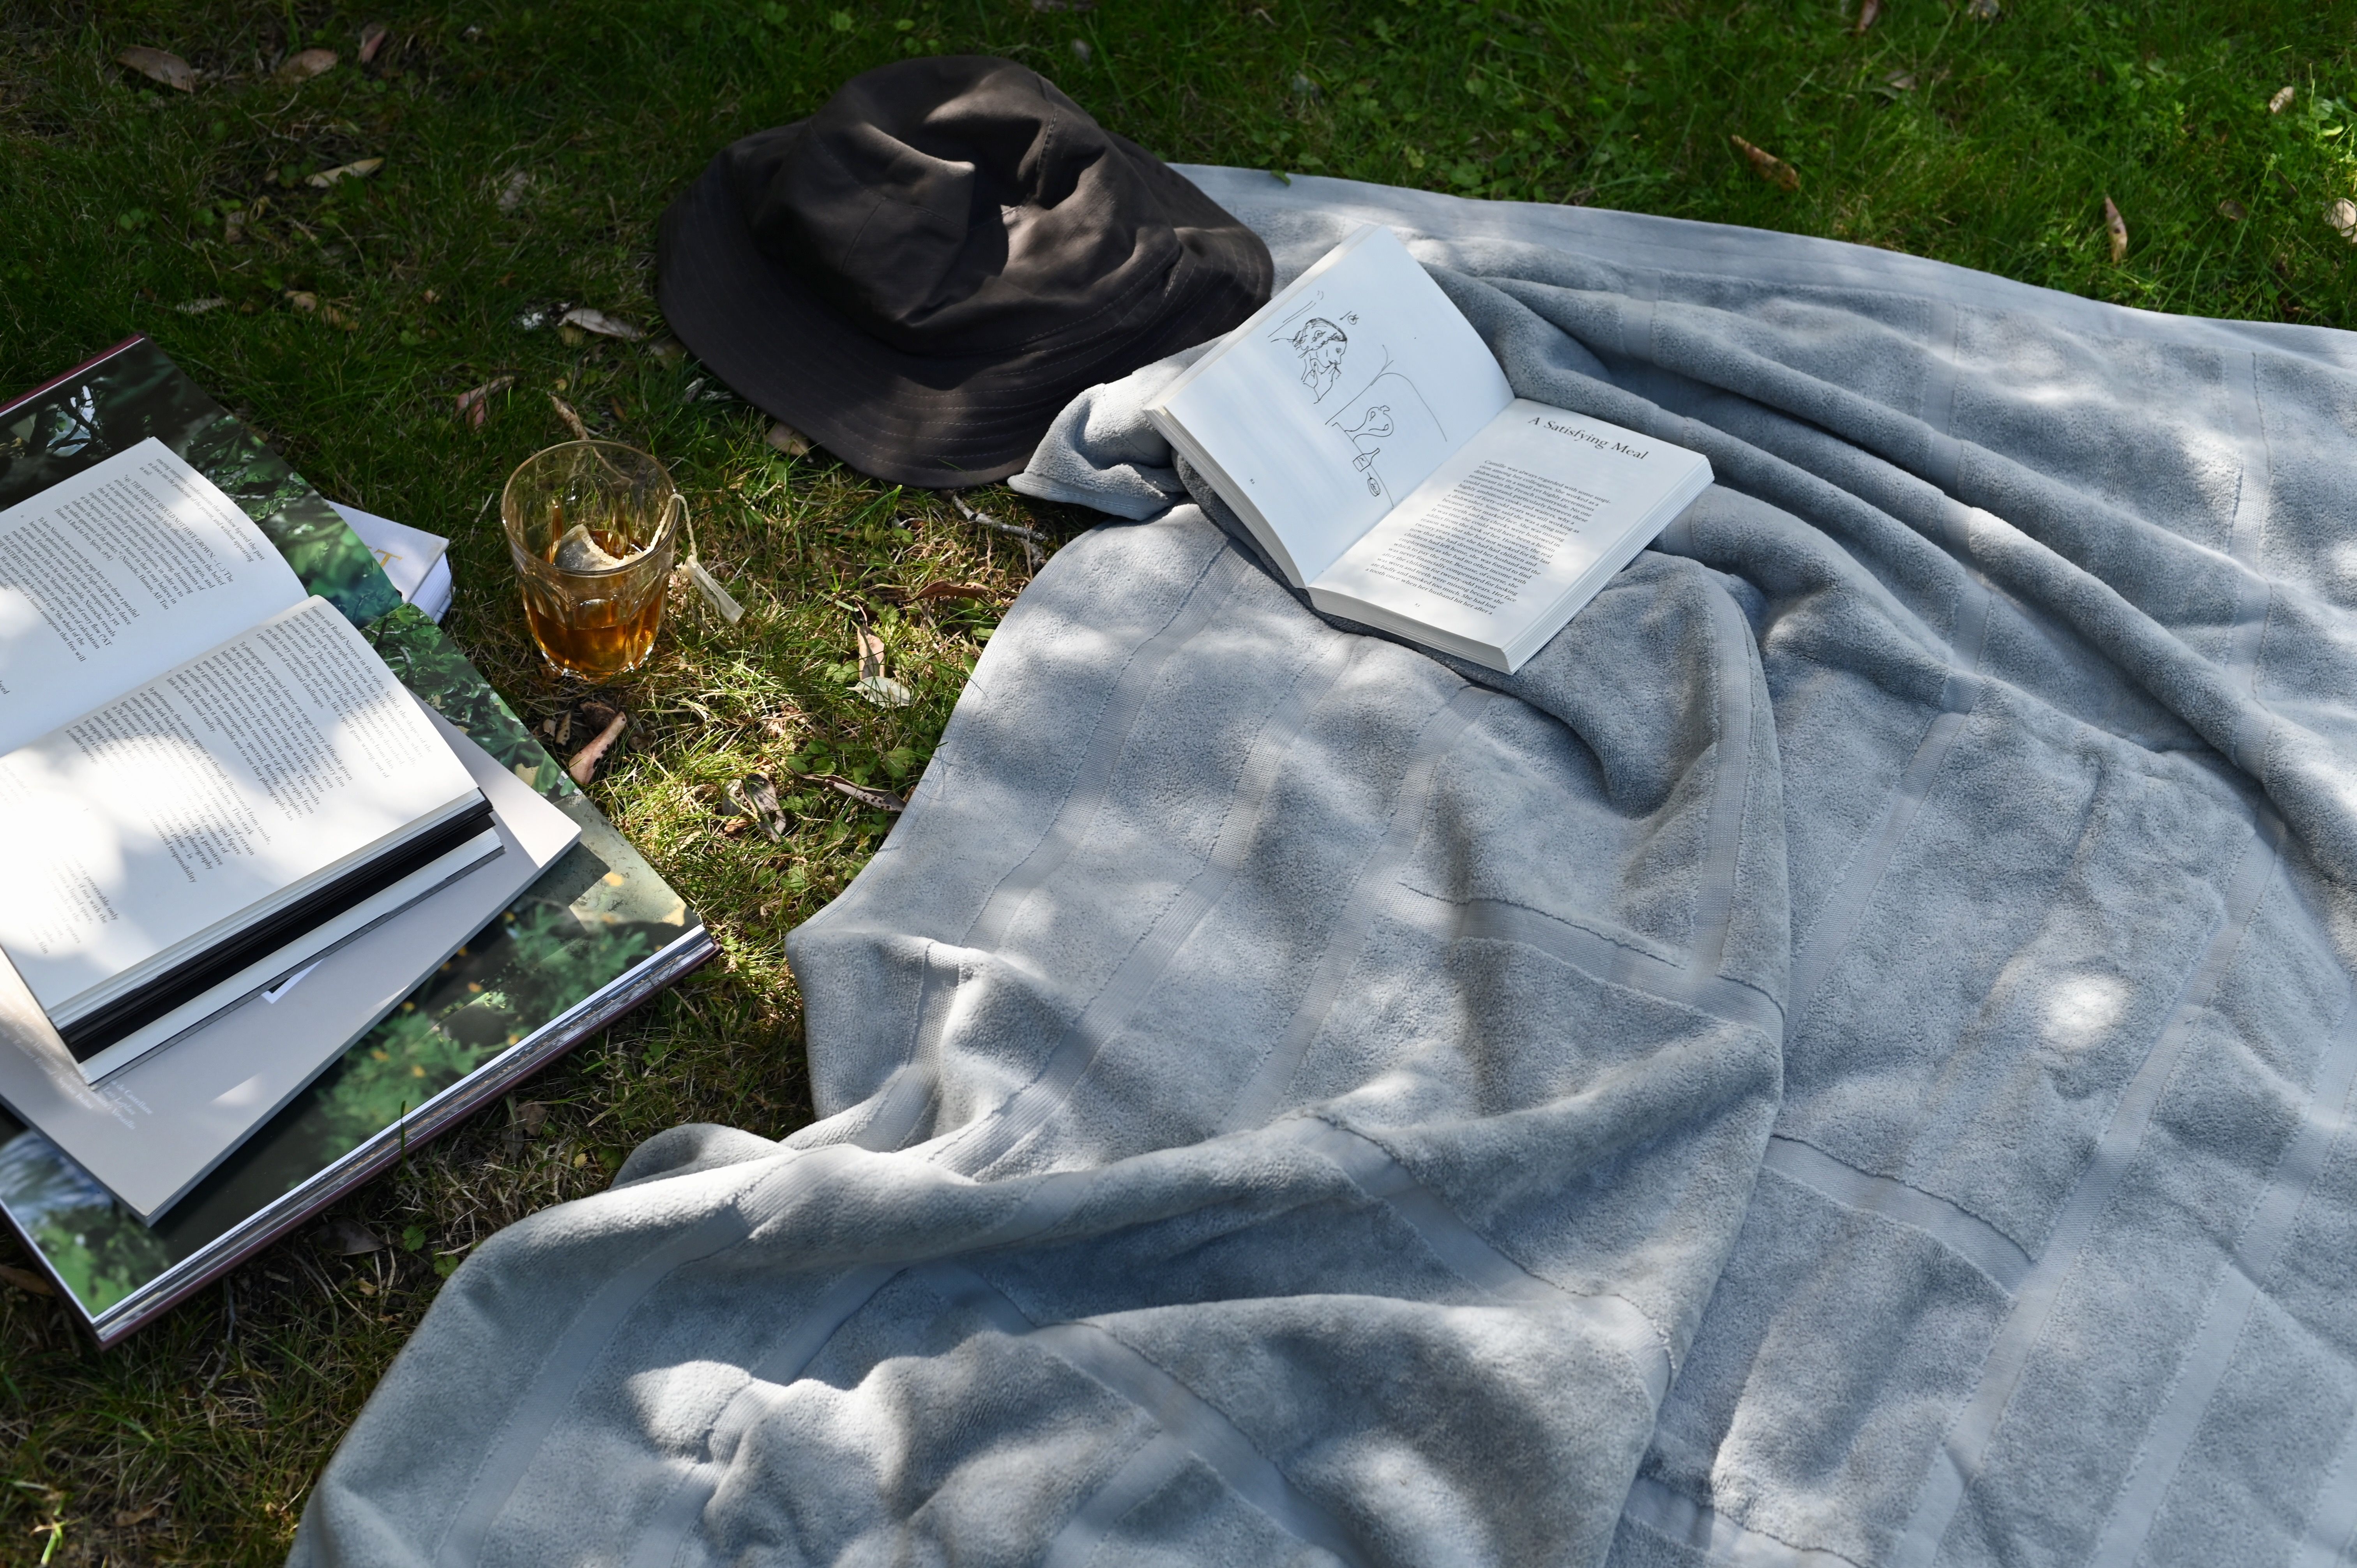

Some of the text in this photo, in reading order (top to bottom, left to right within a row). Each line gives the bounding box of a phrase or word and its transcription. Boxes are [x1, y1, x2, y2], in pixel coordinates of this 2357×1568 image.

[1544, 421, 1608, 449] Satisfying
[1611, 442, 1648, 459] Meal
[1469, 475, 1497, 484] restaurant
[1514, 488, 1536, 496] French
[1535, 496, 1569, 509] countryside.
[1474, 469, 1505, 480] dishwasher
[1542, 491, 1561, 500] highly
[1561, 498, 1595, 511] pretentious
[1484, 460, 1506, 468] Camille
[1538, 477, 1564, 487] regarded
[131, 480, 143, 489] THE
[140, 488, 159, 503] PERFECT
[156, 503, 176, 519] SHOULD
[173, 517, 186, 527] NOT
[183, 526, 198, 539] HAVE
[194, 538, 215, 559] GROWN.
[152, 464, 163, 474] drawn
[171, 484, 192, 498] production
[198, 506, 214, 520] present,
[220, 525, 236, 540] without
[234, 540, 254, 563] appearing
[156, 458, 171, 471] enacting
[170, 468, 189, 484] interpretive
[187, 483, 214, 505] transformations
[219, 512, 237, 528] somehow
[235, 527, 251, 542] figured
[253, 550, 265, 560] past
[1480, 485, 1512, 496] understand,
[1512, 495, 1546, 508] particularly
[1547, 506, 1572, 516] between
[69, 521, 81, 530] Book
[90, 539, 102, 552] Spirits,
[49, 527, 65, 541] Nietzsche
[63, 540, 74, 549] dance
[72, 549, 83, 559] across
[85, 564, 97, 572] page
[95, 571, 104, 579] here
[111, 587, 121, 598] draw
[120, 601, 140, 617] parallel
[1406, 561, 1430, 570] children
[1440, 572, 1475, 586] twenty-odd
[1416, 556, 1446, 569] financially
[1446, 568, 1485, 583] compensated
[1495, 585, 1518, 596] looking
[1429, 588, 1455, 600] husband
[257, 635, 277, 652] particular
[286, 662, 306, 682] technical
[303, 682, 324, 709] challenges.
[310, 606, 325, 620] Fonteyn
[330, 626, 347, 641] Rudolf
[344, 639, 361, 660] Nureyev
[364, 666, 373, 675] the
[371, 675, 384, 691] 1960s.
[384, 690, 401, 710] Stilled,
[241, 646, 267, 666] photograph
[264, 669, 286, 689] principal
[283, 688, 298, 705] dancer
[301, 713, 313, 726] stage
[316, 731, 326, 744] very
[325, 743, 343, 765] difficult
[338, 765, 353, 780] given
[150, 818, 196, 885] conceived responsibility
[83, 876, 117, 922] perceivable only
